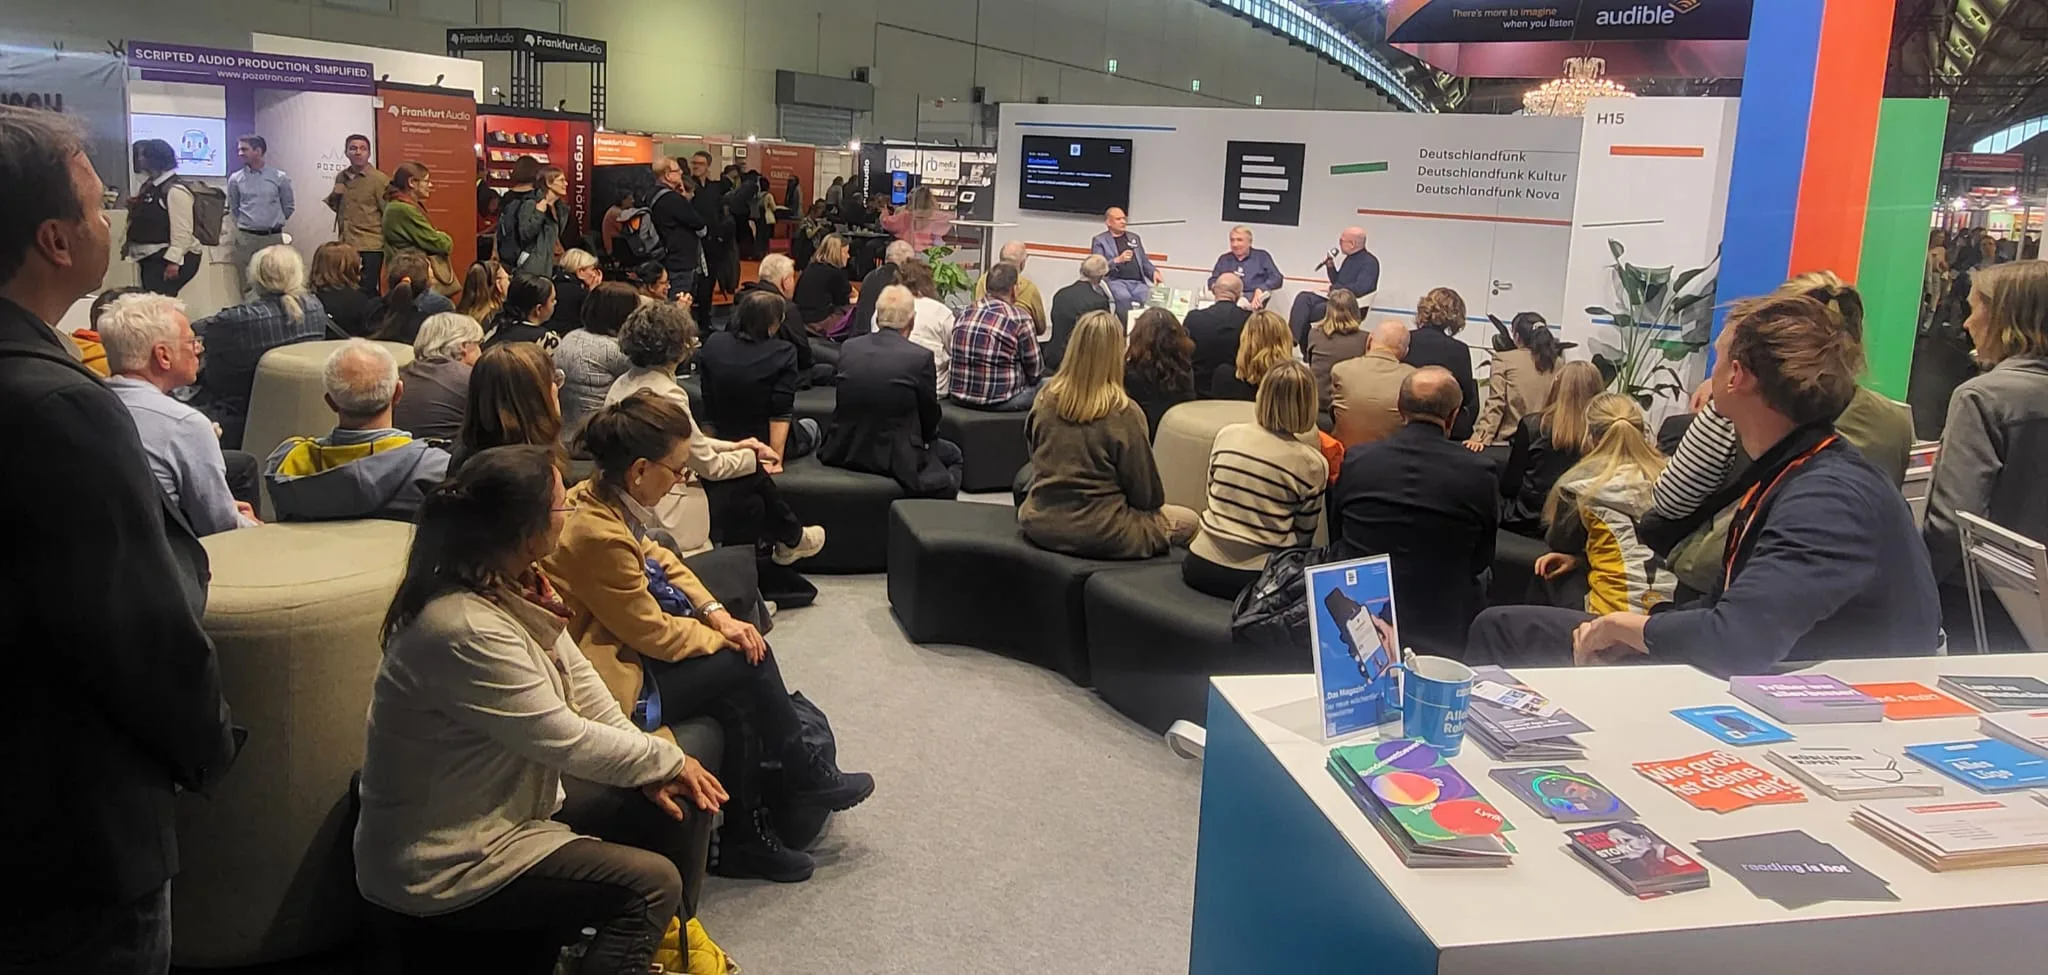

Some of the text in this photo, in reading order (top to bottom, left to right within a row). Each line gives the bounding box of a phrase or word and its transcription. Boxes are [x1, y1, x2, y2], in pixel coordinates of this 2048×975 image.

[1484, 9, 1508, 17] more
[1510, 8, 1519, 17] to
[1520, 7, 1557, 19] imagine
[1596, 6, 1674, 25] audible
[1503, 18, 1574, 30] when you listen
[536, 36, 602, 54] Frankfurt Audio
[135, 48, 370, 78] SCRIPTED AUDIO PRODUCTION, SIMPLIFIED.
[217, 70, 304, 84] www.pozotron.com
[401, 106, 471, 120] Frankfurt Audio
[1597, 113, 1625, 124] H15
[574, 134, 584, 181] argon
[1419, 148, 1526, 162] Deutschlandfunk
[1418, 166, 1567, 182] Deutschlandfunk Kultur
[1416, 183, 1560, 200] Deutschlandfunk Nova
[1649, 751, 1742, 783] Wie groß
[1701, 766, 1764, 789] deine
[1474, 807, 1504, 822] Lyrik
[1741, 862, 1852, 873] reading is hot
